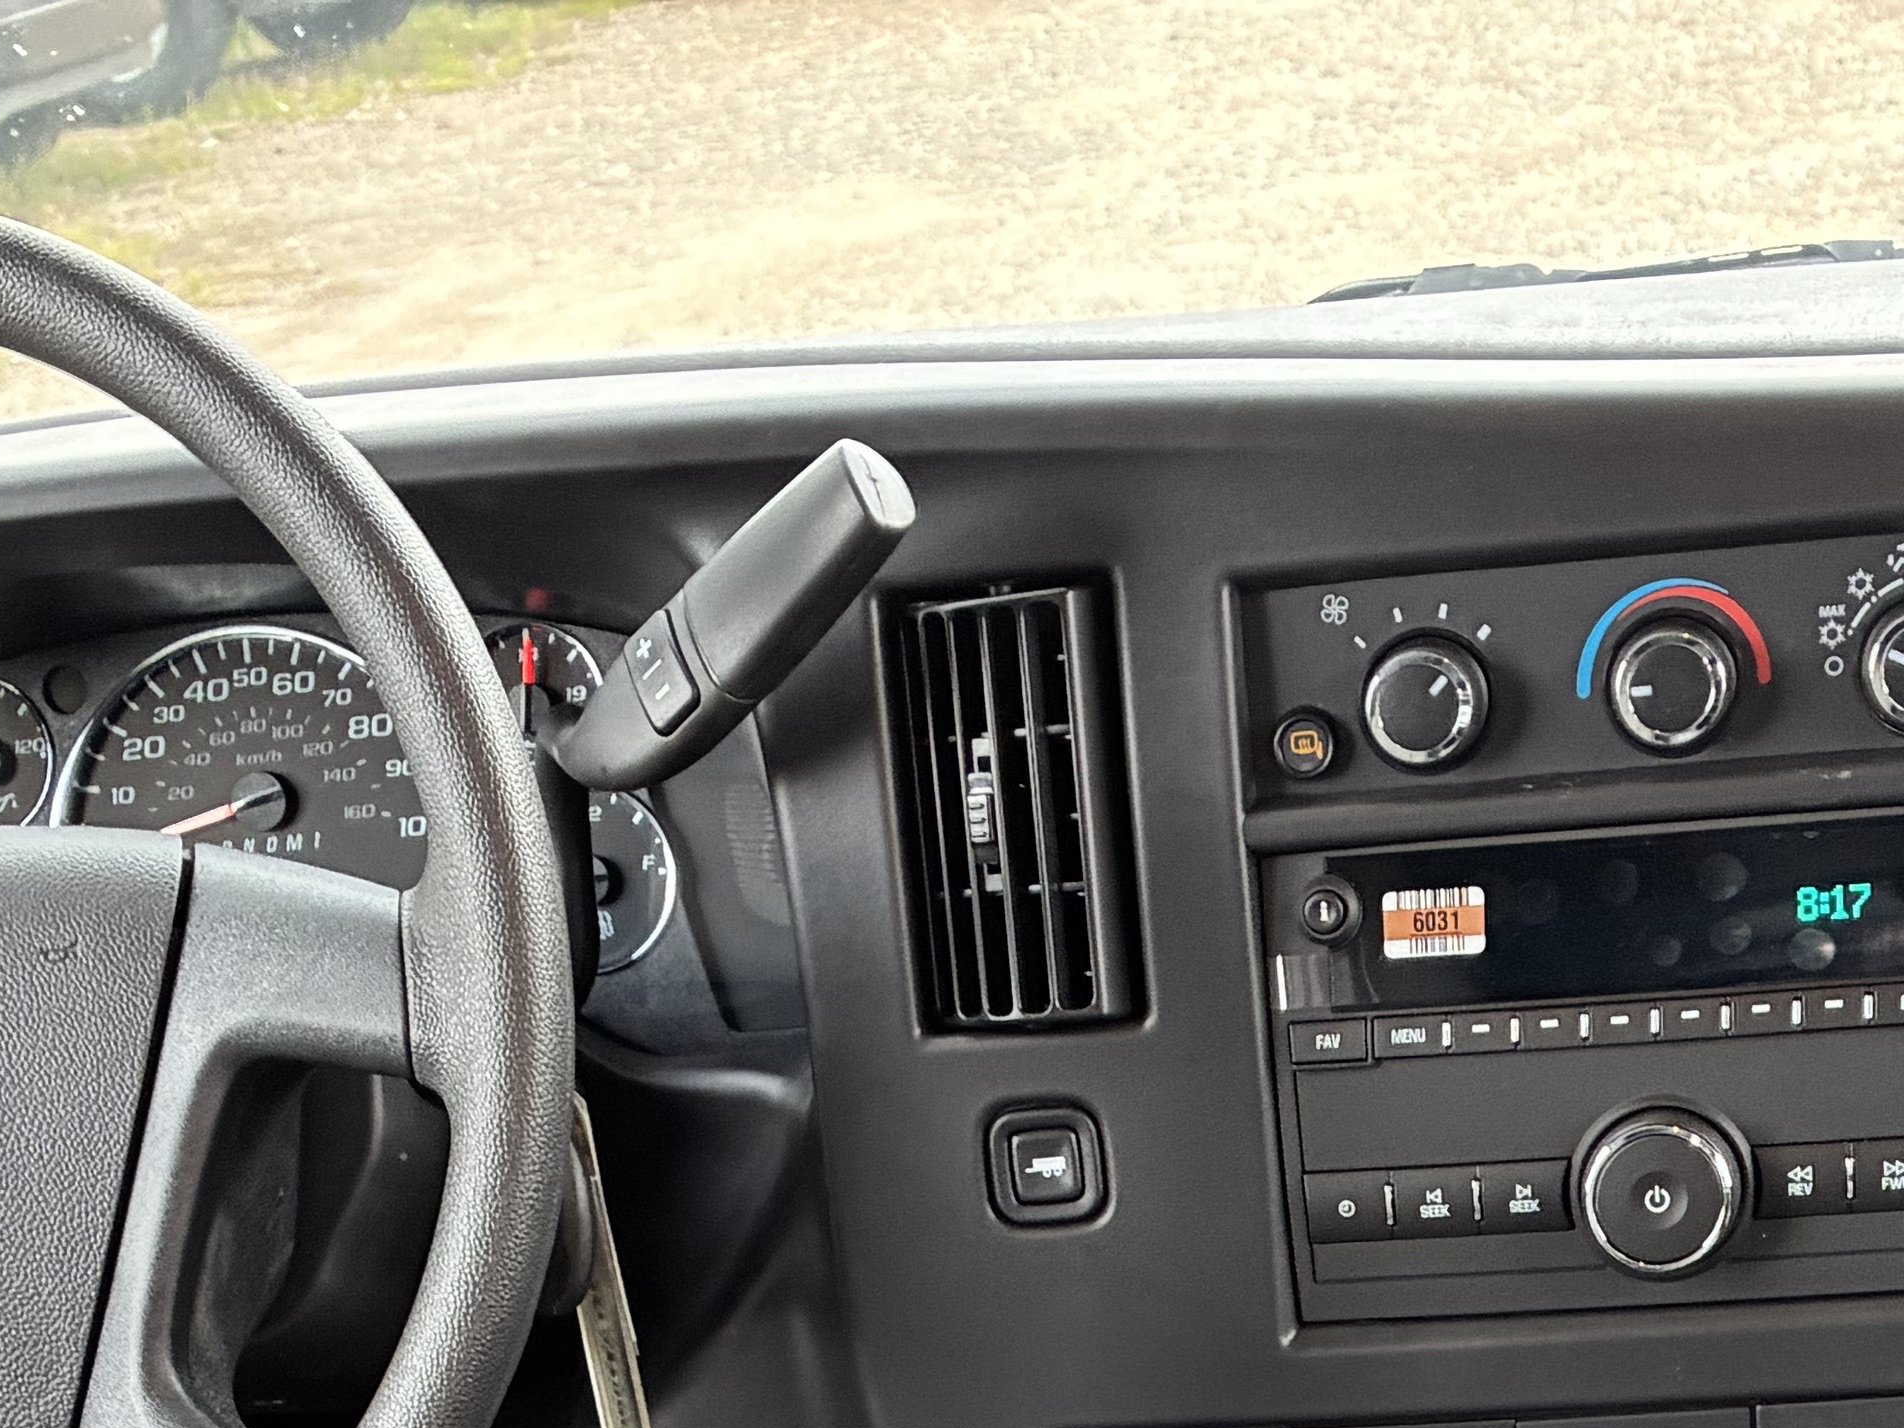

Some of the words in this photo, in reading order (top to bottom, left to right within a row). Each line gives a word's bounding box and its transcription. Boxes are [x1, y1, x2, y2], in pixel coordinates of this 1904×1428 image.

[1818, 603, 1846, 618] MAX
[232, 666, 268, 688] 50
[272, 670, 315, 696] 60
[182, 677, 230, 704] 40
[322, 687, 352, 707] 70
[566, 685, 588, 704] 19
[152, 704, 185, 724] 30
[239, 718, 266, 734] 80
[271, 724, 304, 740] 100
[347, 713, 393, 740] 80
[14, 736, 46, 755] 120
[208, 730, 236, 747] 60
[122, 735, 166, 762] 20
[302, 740, 334, 757] 120
[184, 752, 211, 766] 40
[323, 767, 356, 782] 140
[111, 785, 136, 806] 10
[167, 784, 195, 801] 20
[343, 803, 376, 820] 160
[286, 833, 303, 852] M
[642, 854, 656, 871] F
[1796, 882, 1872, 923] 8:17
[1412, 909, 1461, 932] 6031
[1315, 1033, 1341, 1050] FAV
[1390, 1027, 1427, 1045] MENU
[1787, 1181, 1813, 1196] REV
[1419, 1203, 1451, 1219] SEEK
[1508, 1198, 1541, 1214] SEEK
